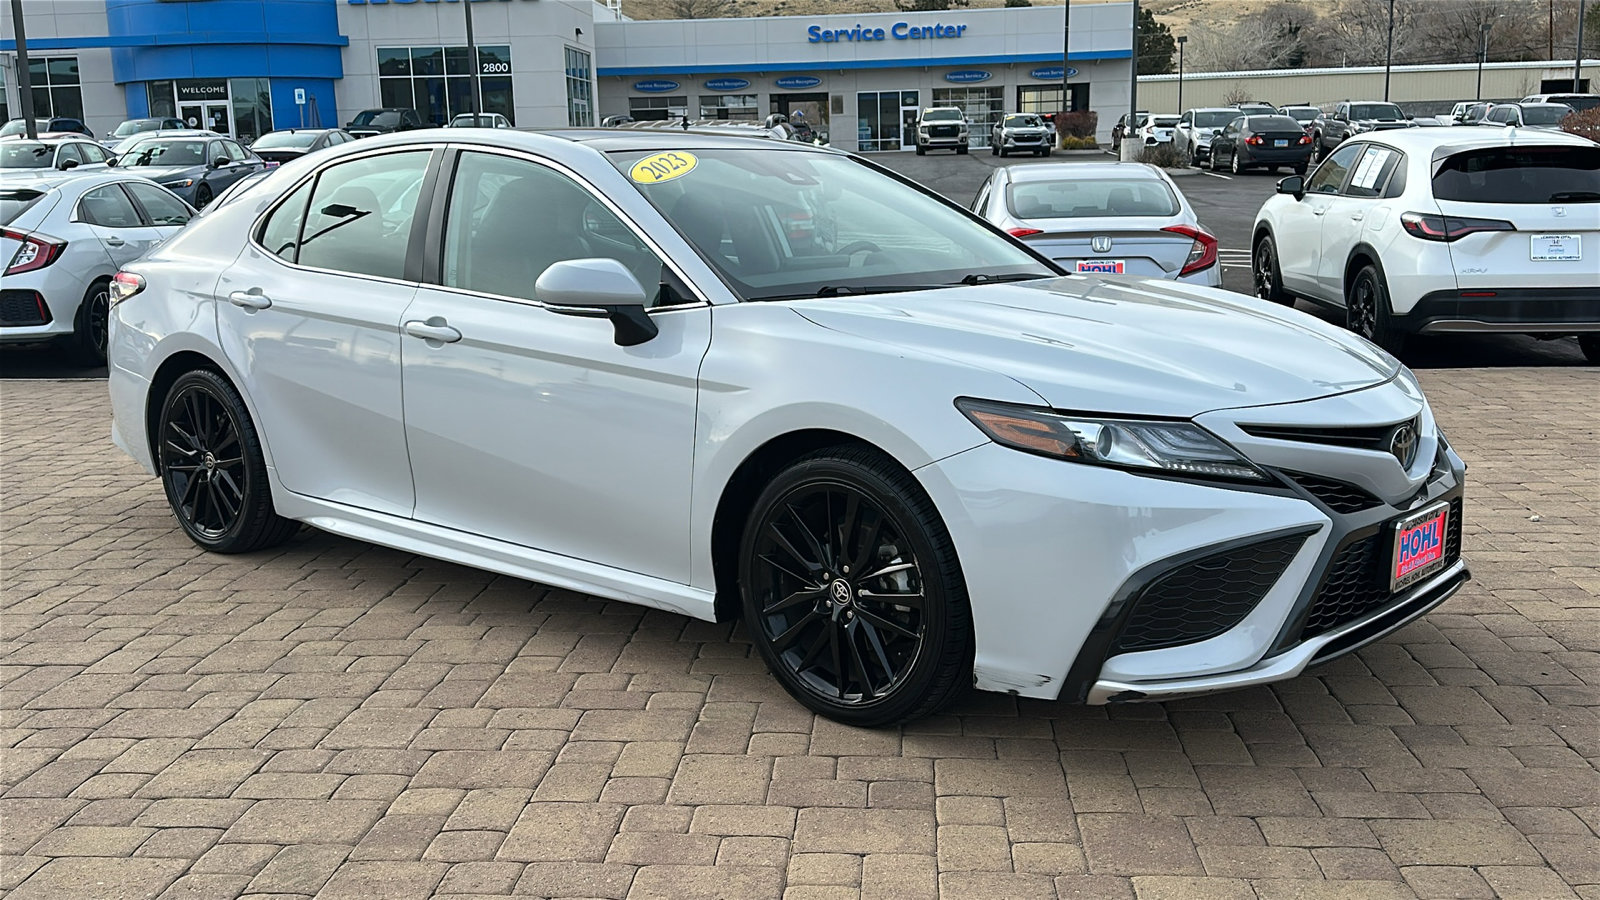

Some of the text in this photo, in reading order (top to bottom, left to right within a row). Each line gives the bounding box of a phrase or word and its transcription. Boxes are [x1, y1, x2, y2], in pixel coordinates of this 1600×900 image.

[807, 22, 968, 43] Service Center
[482, 62, 509, 73] 2800
[181, 86, 225, 94] WELCOME
[640, 153, 688, 180] 2023
[1399, 520, 1440, 564] HOHL
